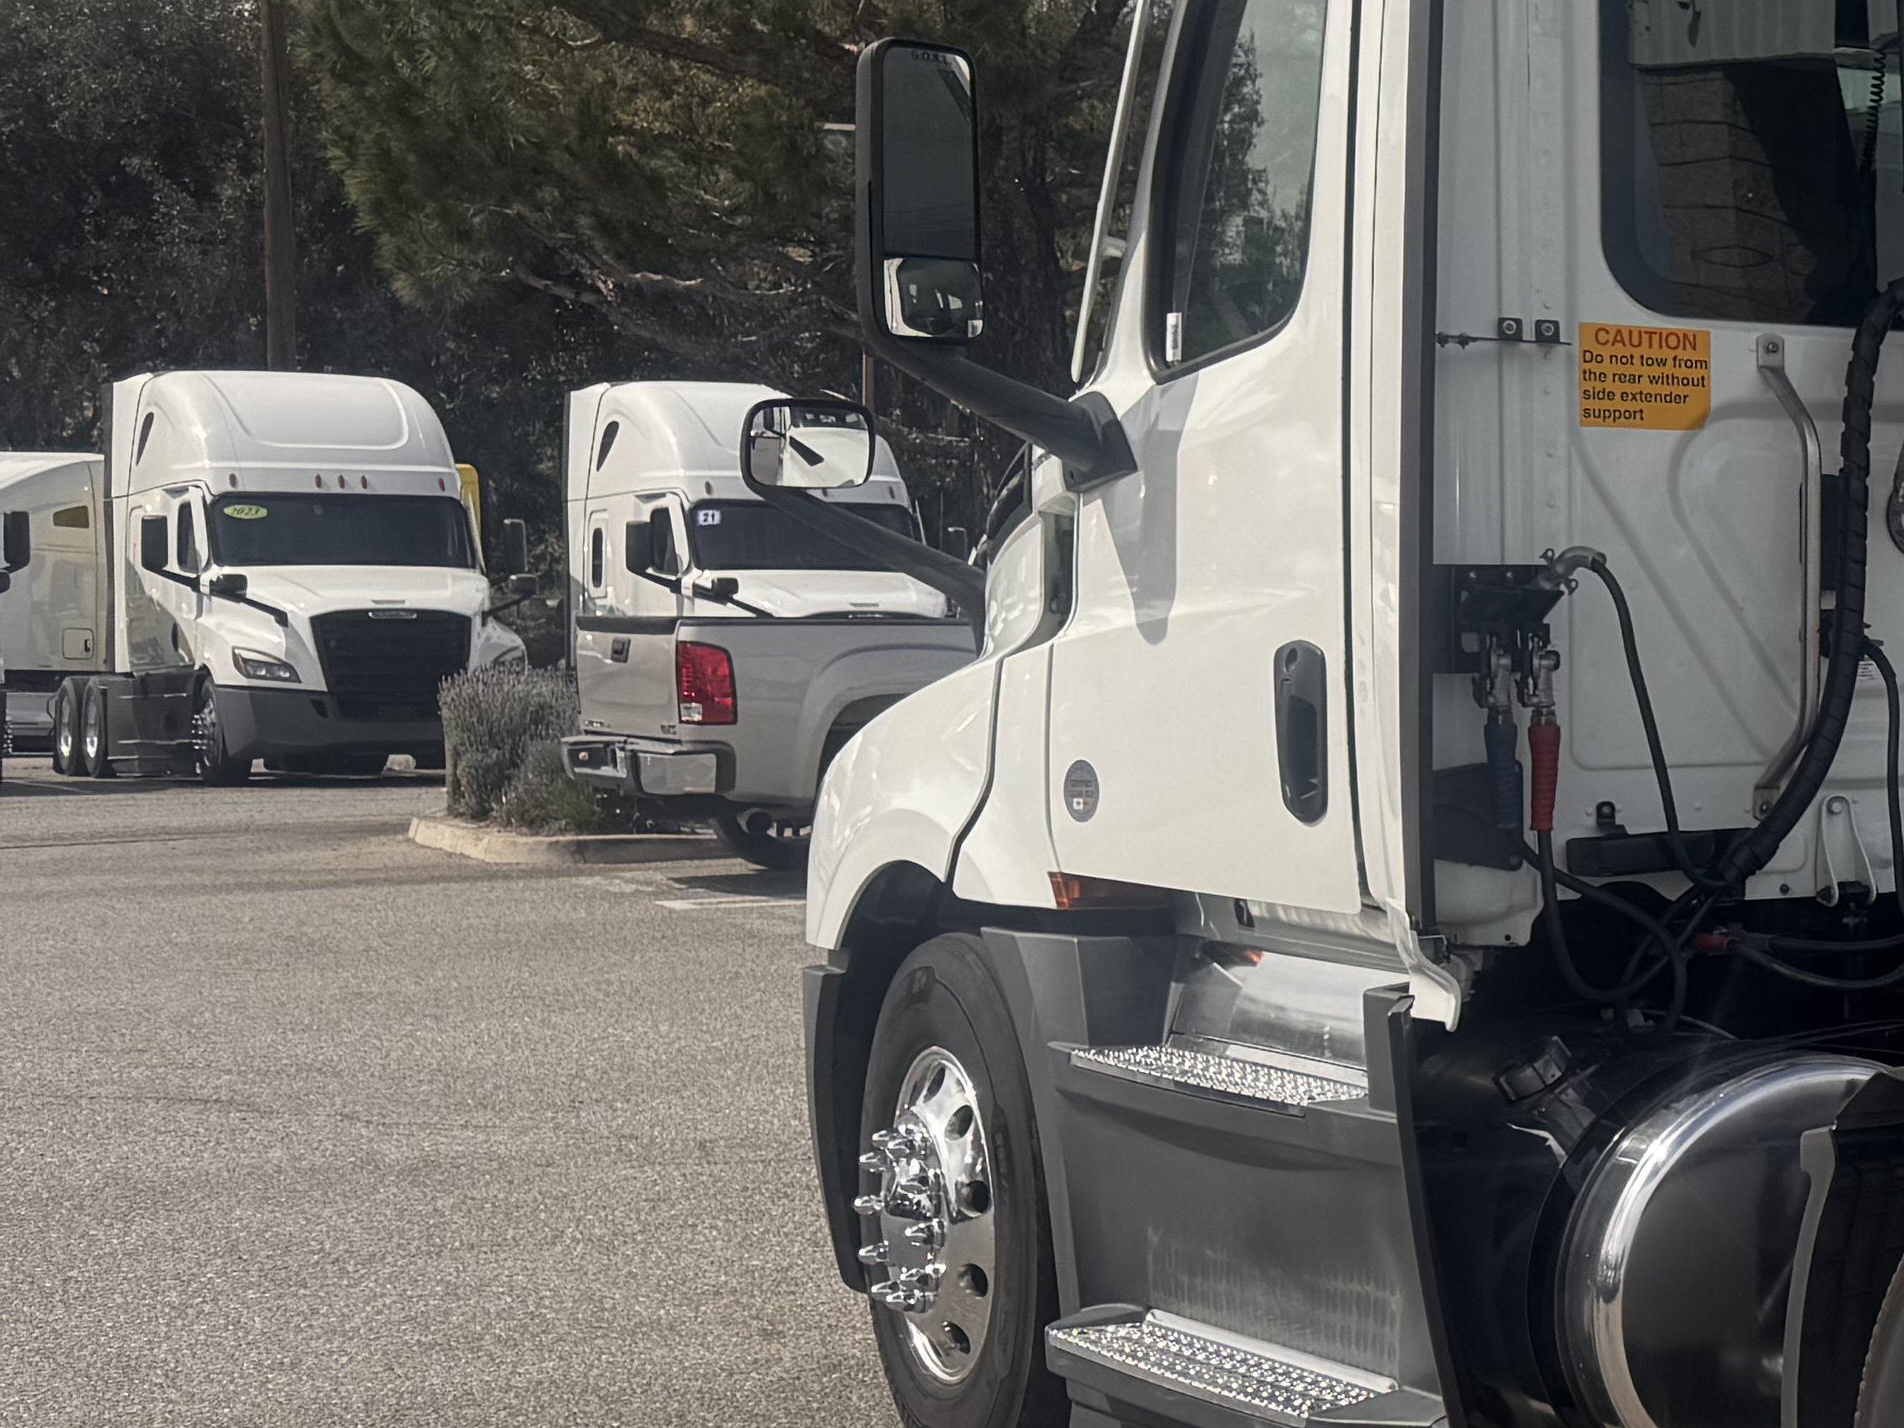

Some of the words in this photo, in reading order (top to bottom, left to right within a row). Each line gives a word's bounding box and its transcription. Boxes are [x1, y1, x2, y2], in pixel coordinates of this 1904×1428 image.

[1595, 327, 1697, 351] CAUTION
[1583, 350, 1604, 364] Do
[1609, 354, 1634, 366] not
[1640, 354, 1667, 367] tow
[1672, 355, 1708, 370] from
[1583, 369, 1607, 382] the
[1612, 372, 1643, 384] rear
[1648, 372, 1706, 388] without
[1583, 387, 1615, 401] side
[1620, 390, 1689, 404] extender
[1583, 408, 1644, 423] support
